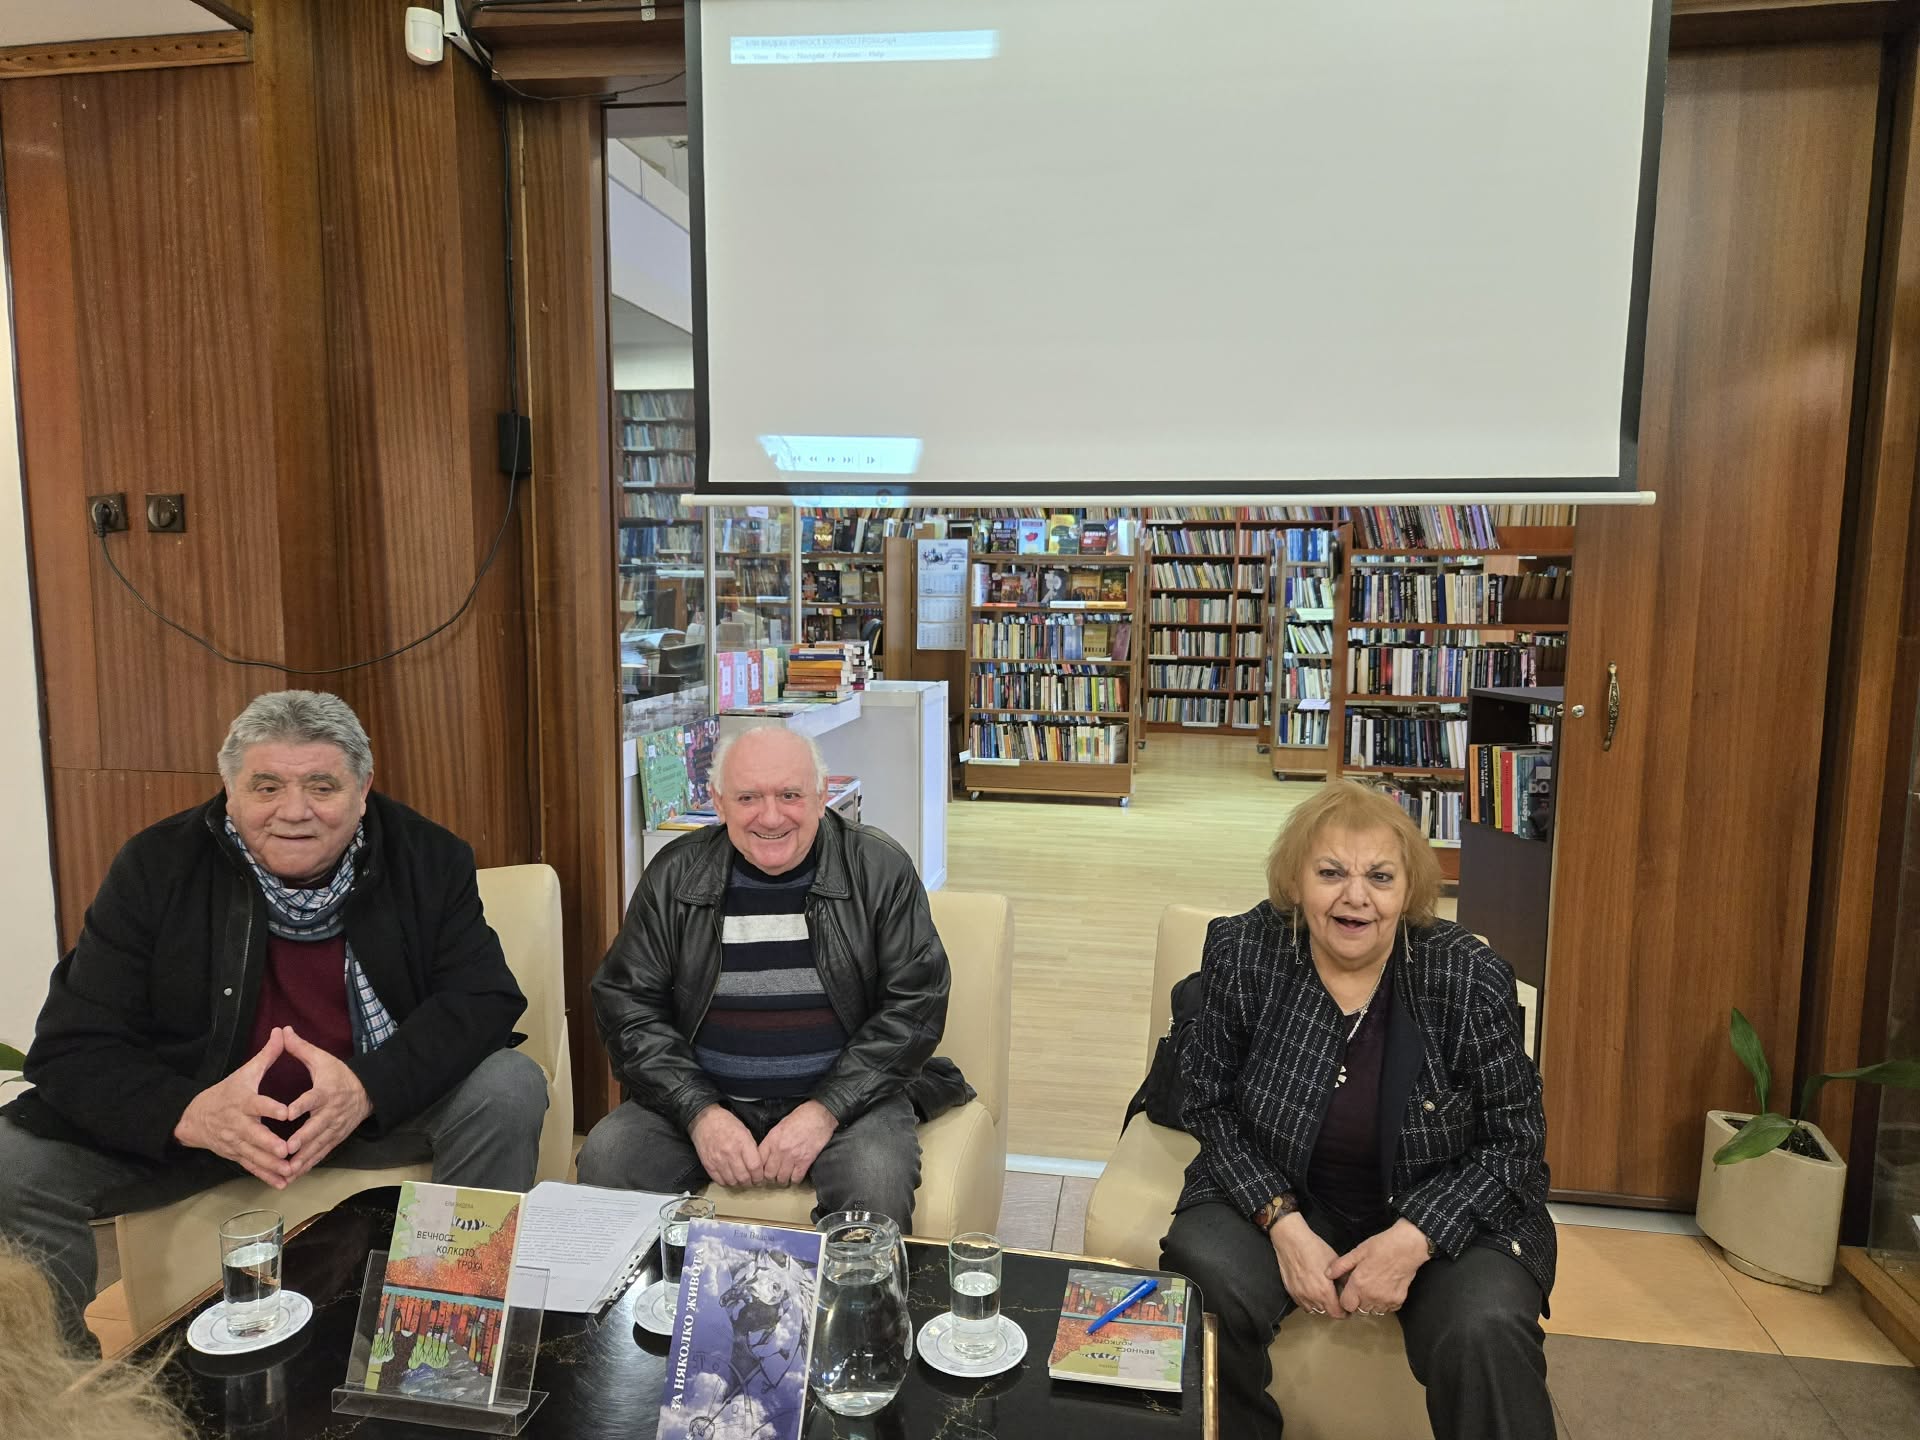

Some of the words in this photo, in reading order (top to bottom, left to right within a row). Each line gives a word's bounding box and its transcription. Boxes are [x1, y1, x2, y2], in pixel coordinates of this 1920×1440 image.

[416, 1230, 457, 1242] ВЕЧНОСТ
[436, 1245, 476, 1257] КОЛКОТО
[457, 1259, 484, 1272] ТРОХА
[686, 1248, 704, 1312] ЖИВОТА
[673, 1314, 695, 1391] НЯКОЛКО
[671, 1393, 683, 1413] ЗА
